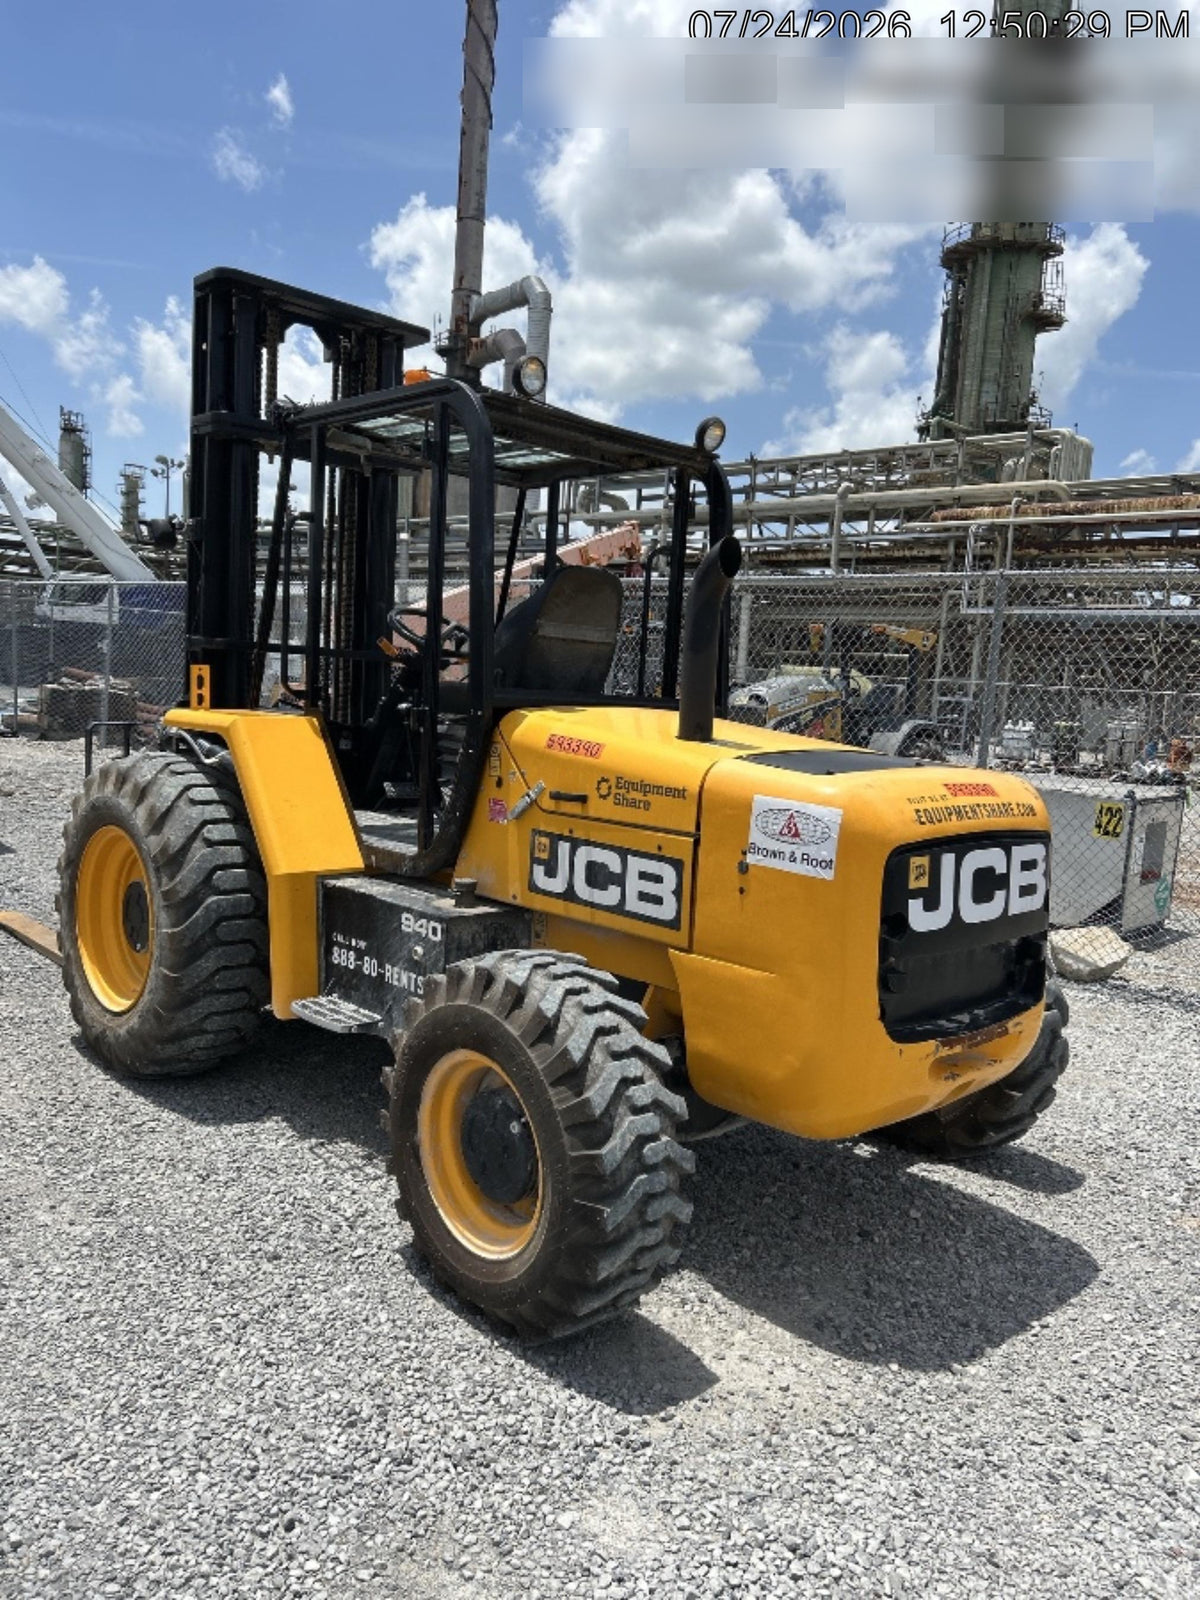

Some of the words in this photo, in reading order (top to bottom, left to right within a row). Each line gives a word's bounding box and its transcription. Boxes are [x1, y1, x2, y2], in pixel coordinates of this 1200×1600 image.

[613, 793, 651, 811] Share
[615, 776, 687, 800] Equipment
[914, 802, 1037, 826] EQUIPMENTSHARE.COM
[747, 842, 785, 861] Brown
[788, 851, 798, 864] &
[800, 852, 834, 870] Root
[532, 839, 679, 921] JCB
[907, 842, 1048, 932] JCB
[400, 912, 442, 942] 940
[332, 945, 425, 995] 888-80-RENTS
